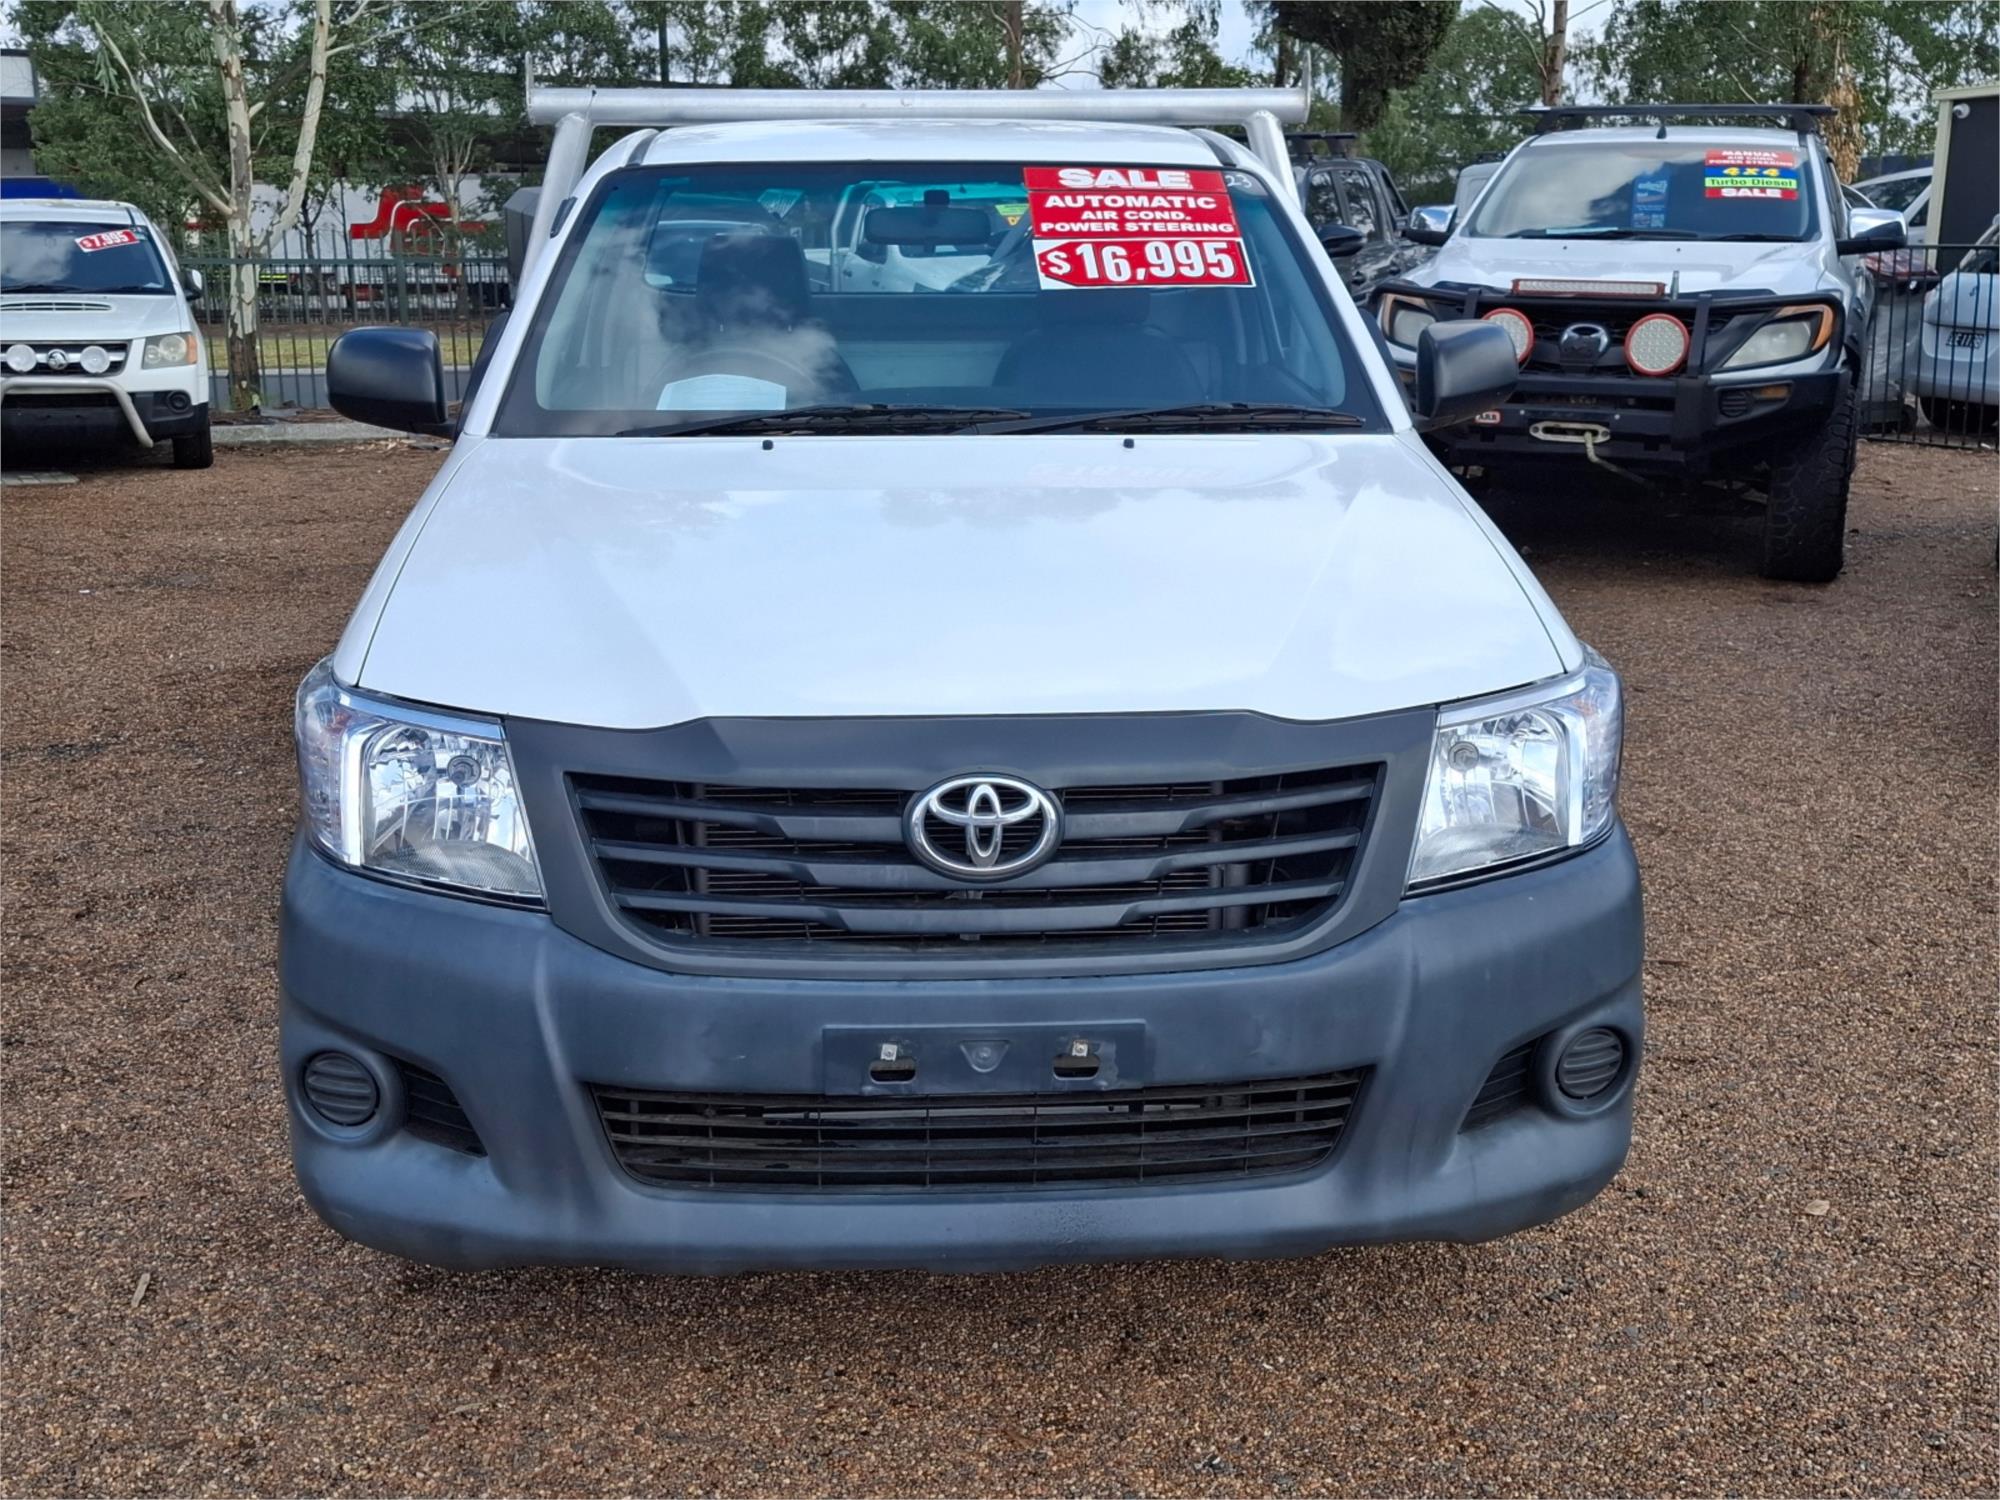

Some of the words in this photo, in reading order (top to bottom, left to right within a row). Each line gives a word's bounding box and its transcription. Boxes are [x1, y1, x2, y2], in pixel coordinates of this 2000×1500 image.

[1058, 168, 1193, 190] SALE
[1752, 179, 1793, 187] Diesel
[1721, 188, 1782, 198] SALE
[1045, 194, 1217, 209] AUTOMATIC
[1080, 210, 1119, 220] AIR
[1124, 211, 1192, 221] COND.
[1040, 222, 1120, 232] POWER
[1124, 222, 1235, 233] STEERING
